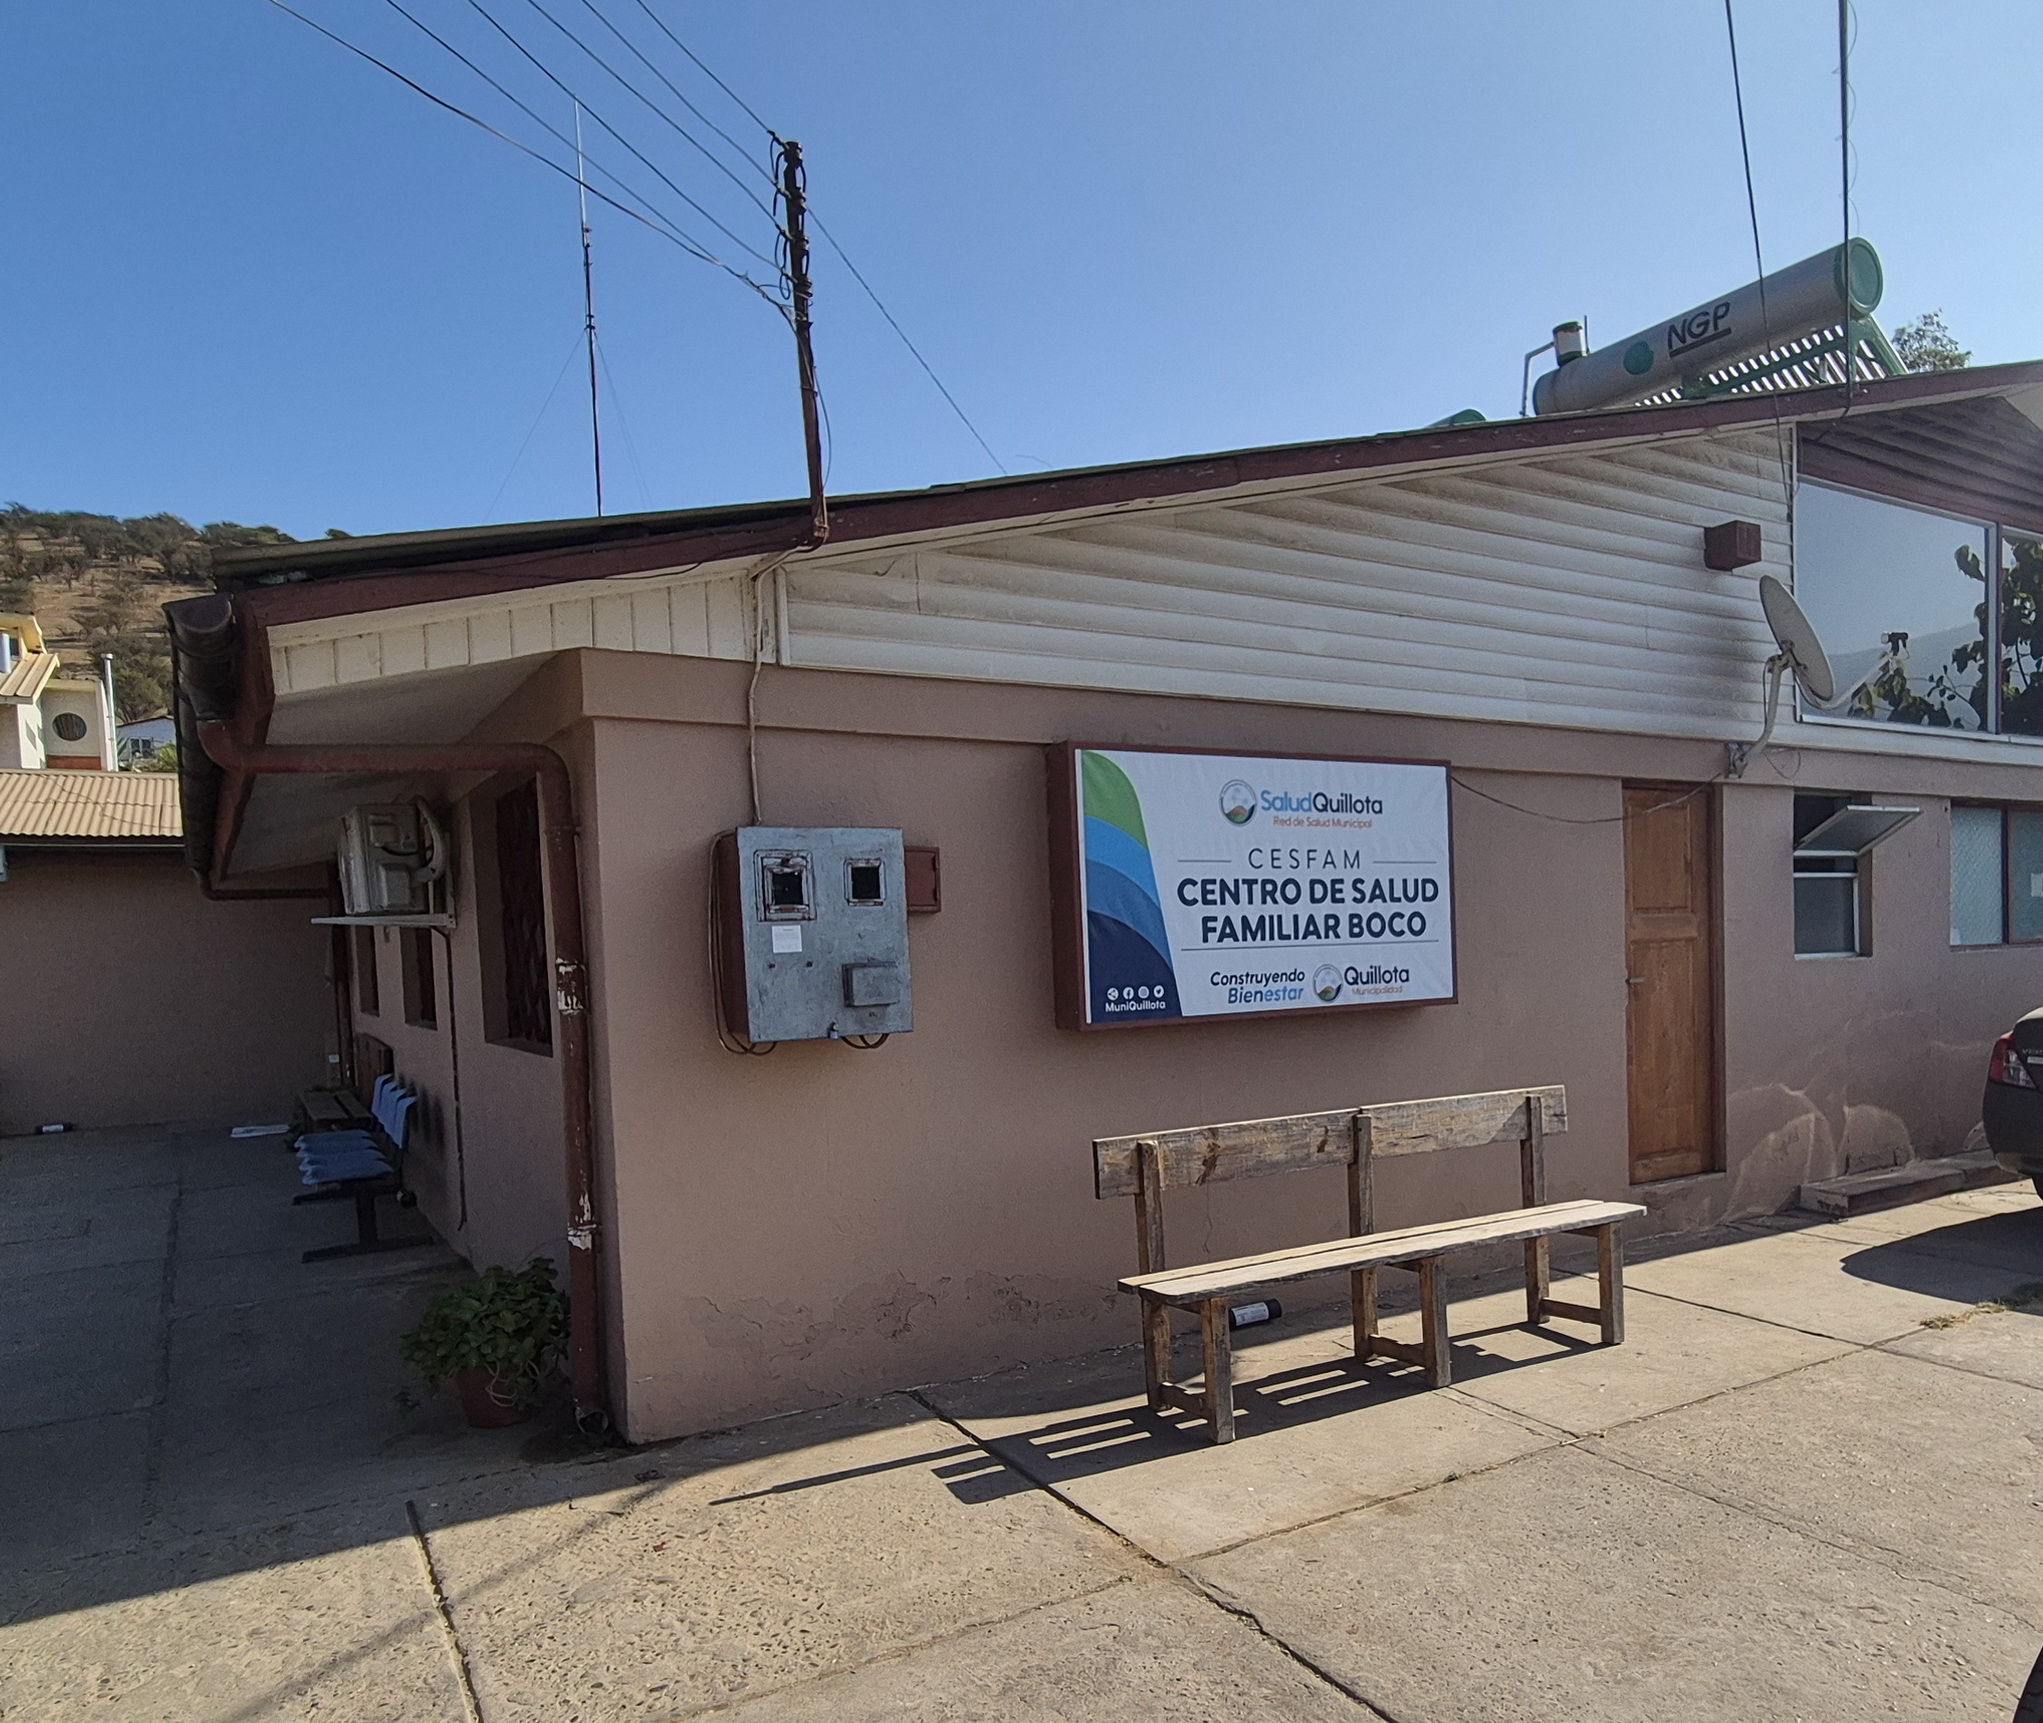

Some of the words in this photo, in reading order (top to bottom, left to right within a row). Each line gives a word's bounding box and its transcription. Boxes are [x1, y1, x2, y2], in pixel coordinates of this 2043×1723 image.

[1667, 301, 1730, 350] NGP
[1260, 789, 1383, 815] SaludQuillota
[1273, 816, 1291, 827] Red
[1293, 817, 1304, 827] de
[1306, 817, 1330, 828] Salud
[1332, 819, 1373, 829] Municipal
[1248, 848, 1361, 870] CESFAM
[1177, 877, 1302, 907] CENTRO
[1308, 878, 1346, 905] DE
[1351, 877, 1439, 904] SALUD
[1201, 913, 1341, 944] FAMILIAR
[1348, 911, 1427, 939] BOCO
[1210, 968, 1306, 987] Construyendo
[1344, 965, 1410, 986] Quillota
[1227, 986, 1305, 1004] Bienestar
[1351, 985, 1404, 996] Municipalidad
[1104, 1000, 1167, 1013] MuniQuillota
